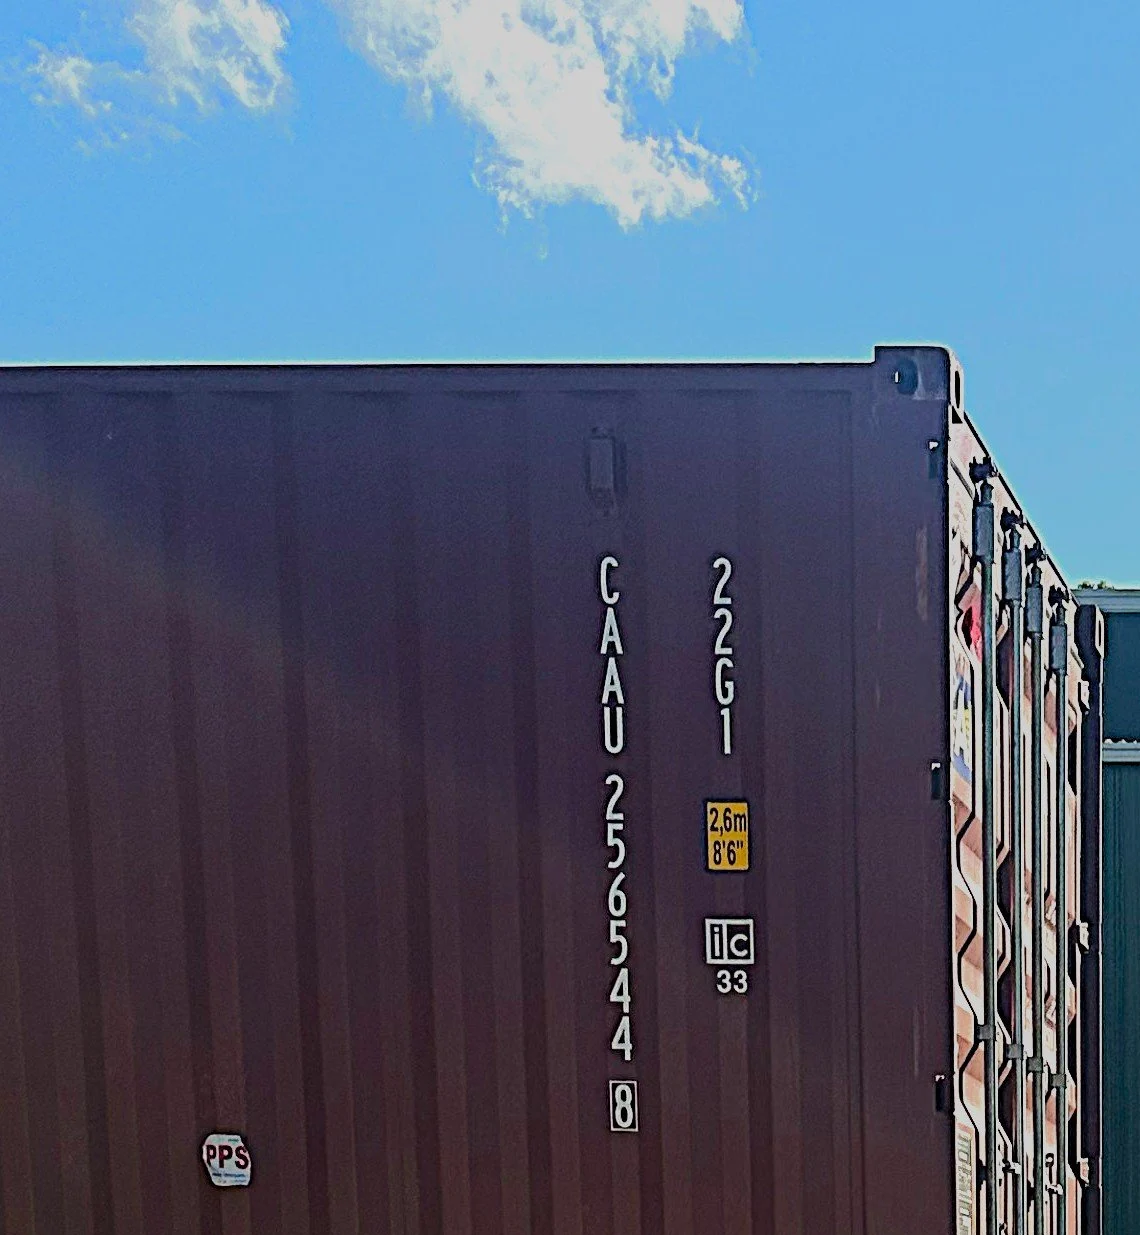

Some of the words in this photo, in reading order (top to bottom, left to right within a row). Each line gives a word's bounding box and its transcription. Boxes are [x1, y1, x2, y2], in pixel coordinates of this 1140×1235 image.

[600, 556, 624, 754] CAAU
[713, 557, 734, 754] 22G1
[709, 807, 747, 836] 2,6m
[605, 774, 632, 1060] 256544
[716, 969, 748, 994] 33
[614, 1084, 634, 1128] 8
[206, 1144, 249, 1169] PPS
